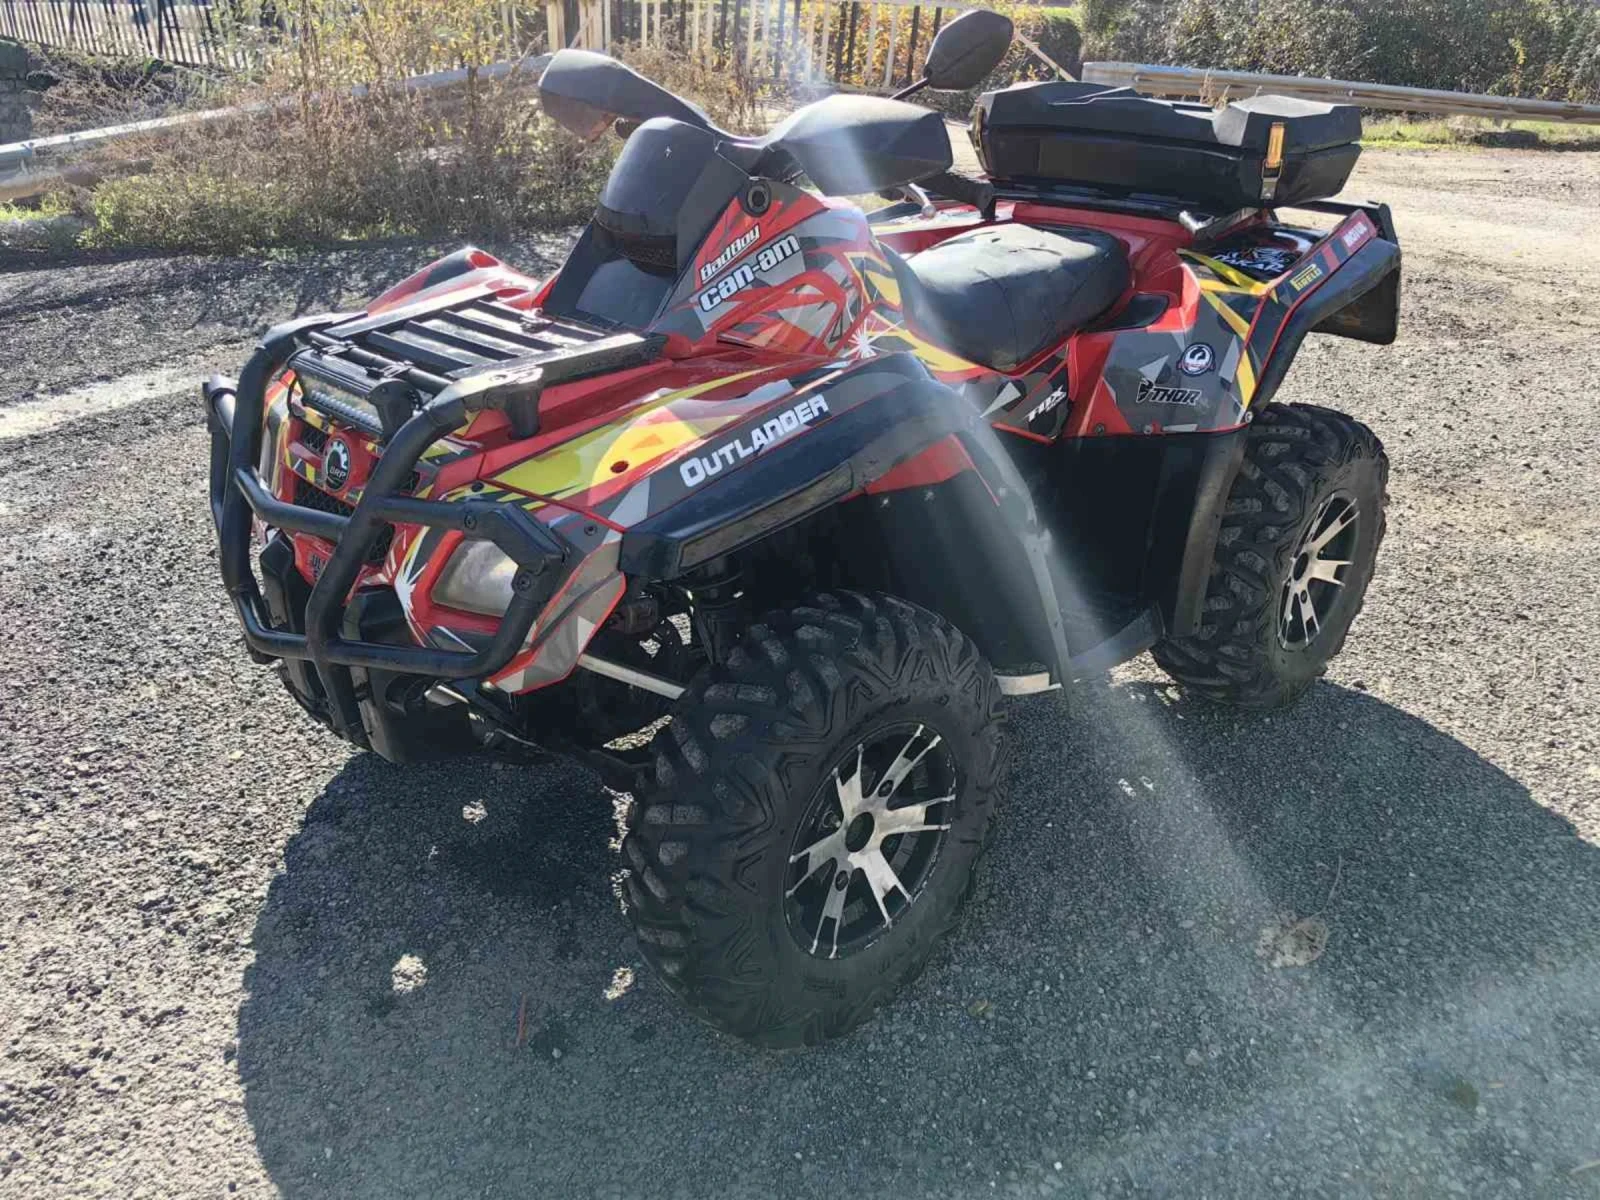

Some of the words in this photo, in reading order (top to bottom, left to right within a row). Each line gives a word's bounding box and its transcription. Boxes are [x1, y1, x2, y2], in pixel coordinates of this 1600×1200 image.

[700, 224, 760, 281] BadBoy
[1150, 386, 1202, 405] THOR
[679, 394, 829, 488] OUTLANDER
[329, 466, 347, 480] BRP
